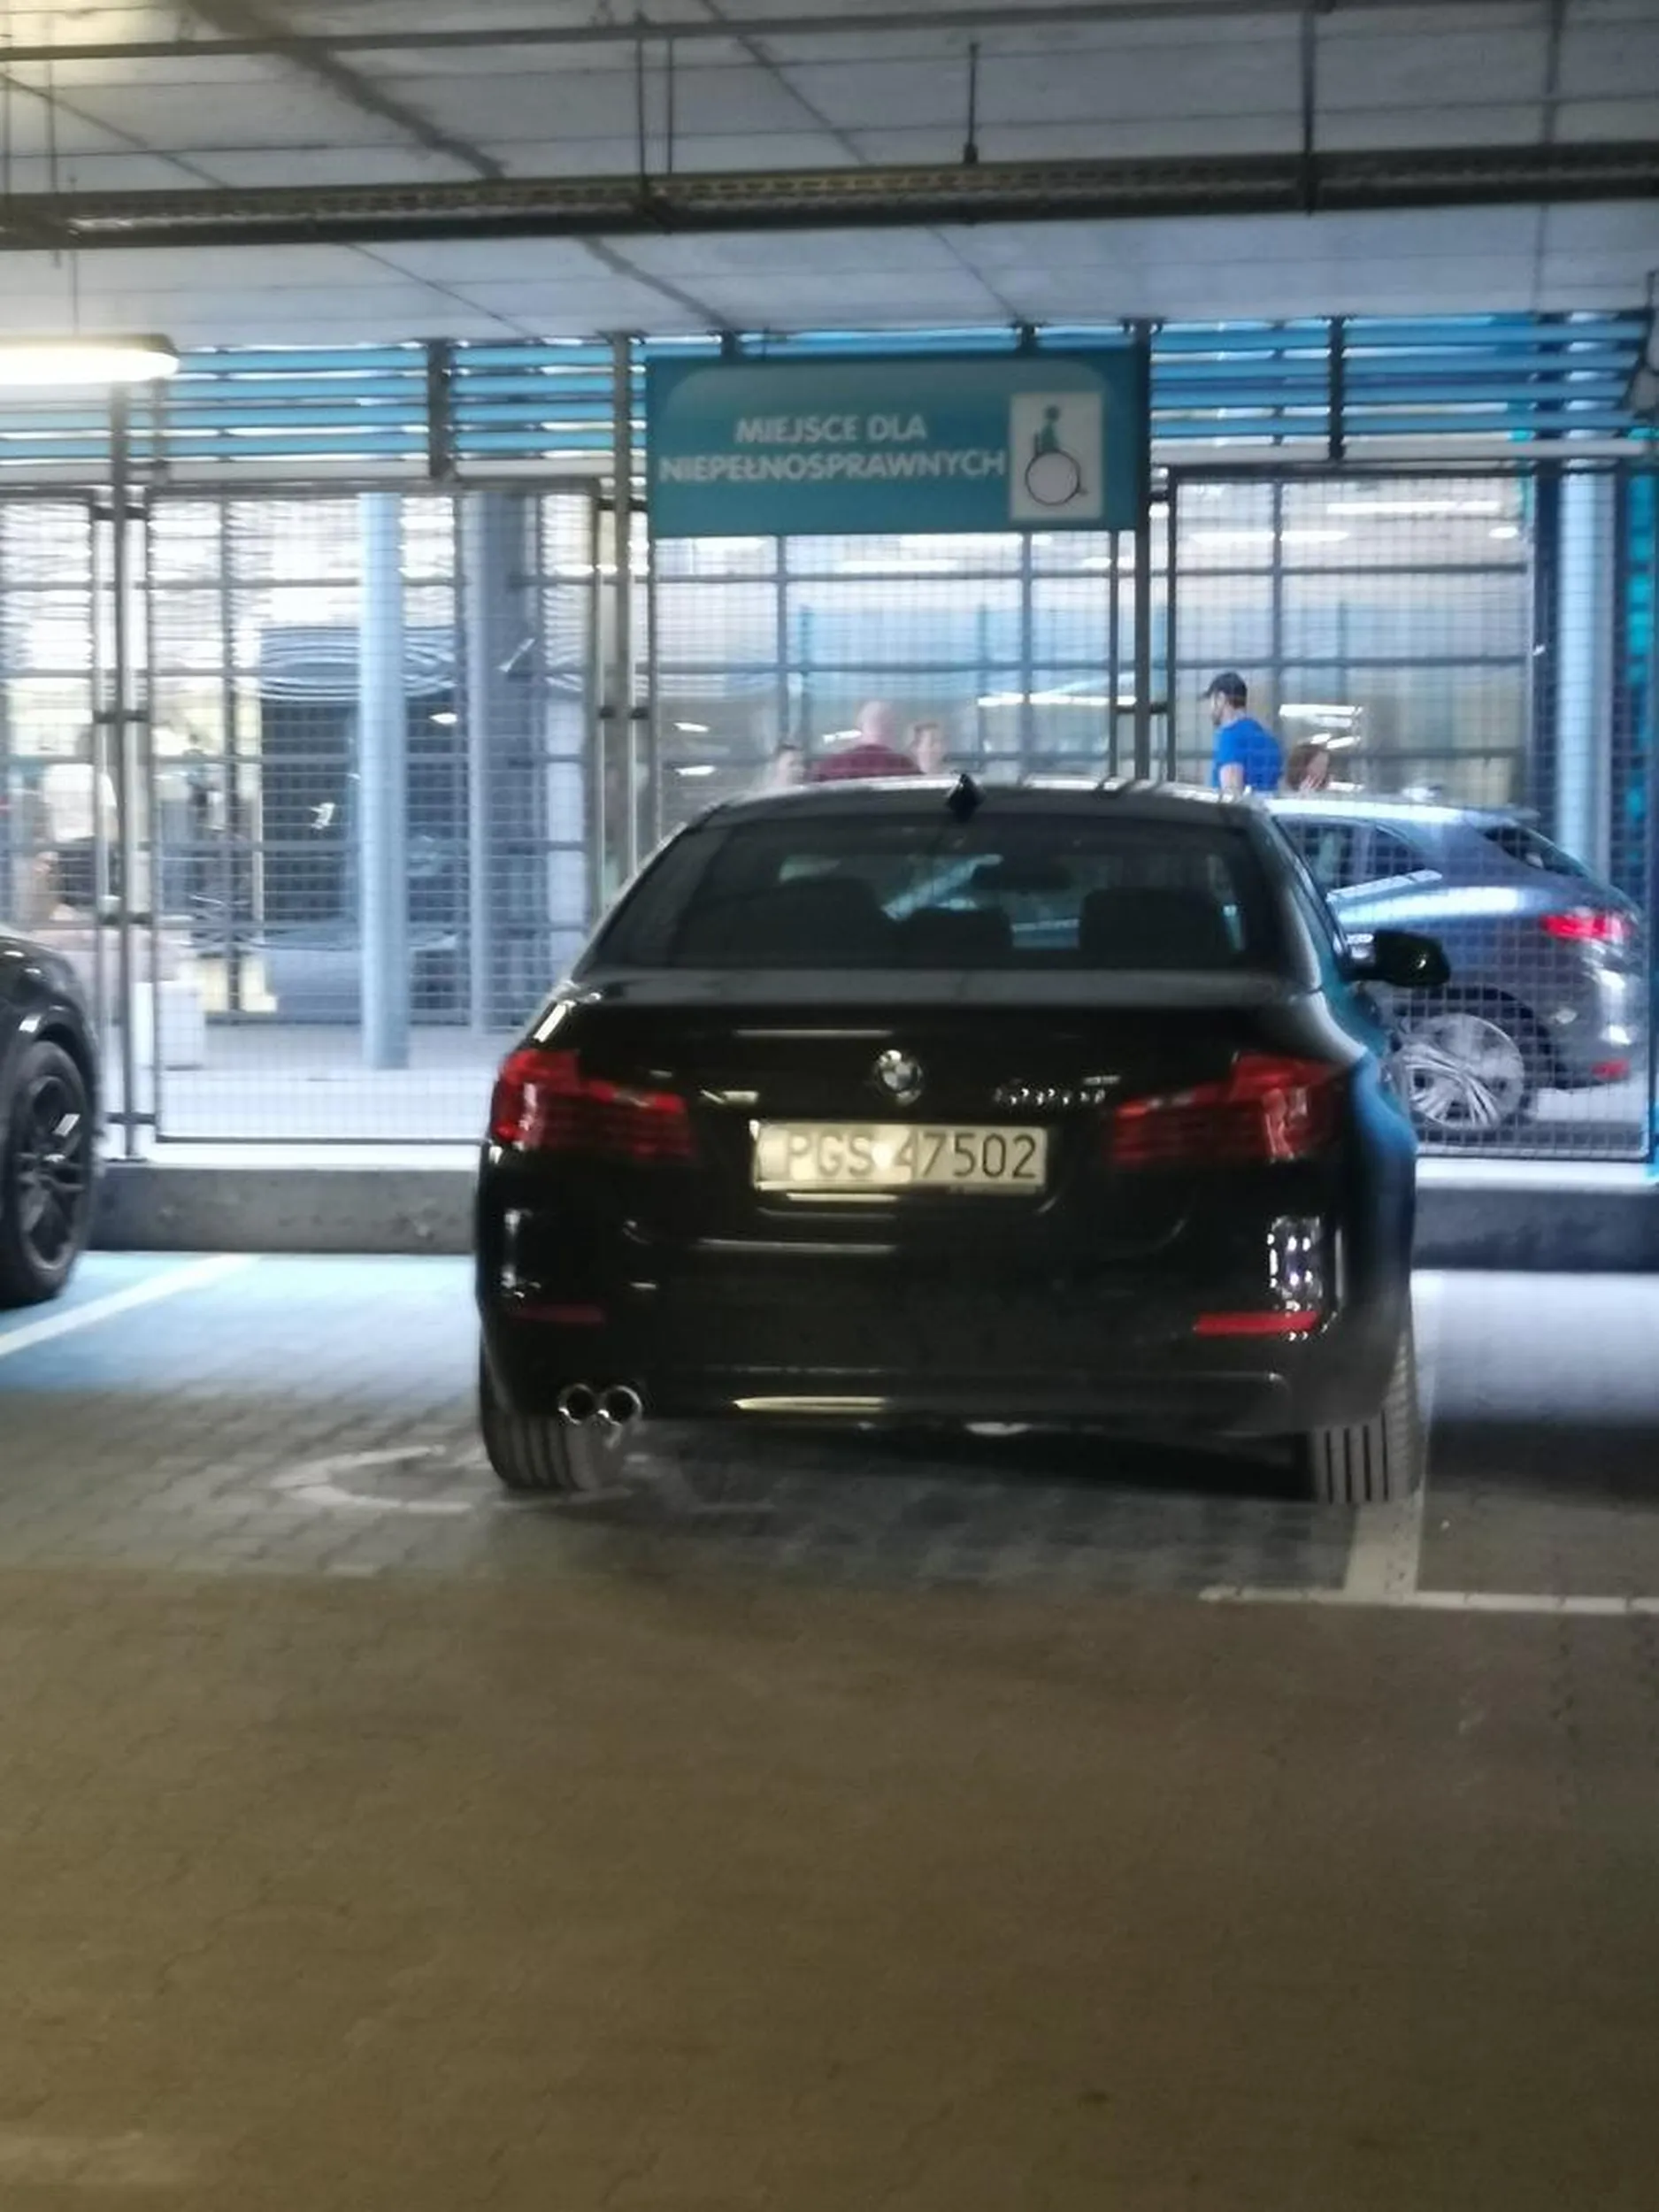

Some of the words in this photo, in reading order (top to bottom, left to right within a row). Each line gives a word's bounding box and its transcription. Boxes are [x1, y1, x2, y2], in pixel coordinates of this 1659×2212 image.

[735, 414, 857, 443] MIEJSCE
[868, 413, 926, 440] DLA
[660, 449, 1005, 481] NIEPEŁNOSPRAWNYCH
[786, 1131, 872, 1179] PGS
[895, 1133, 1037, 1179] 47502
